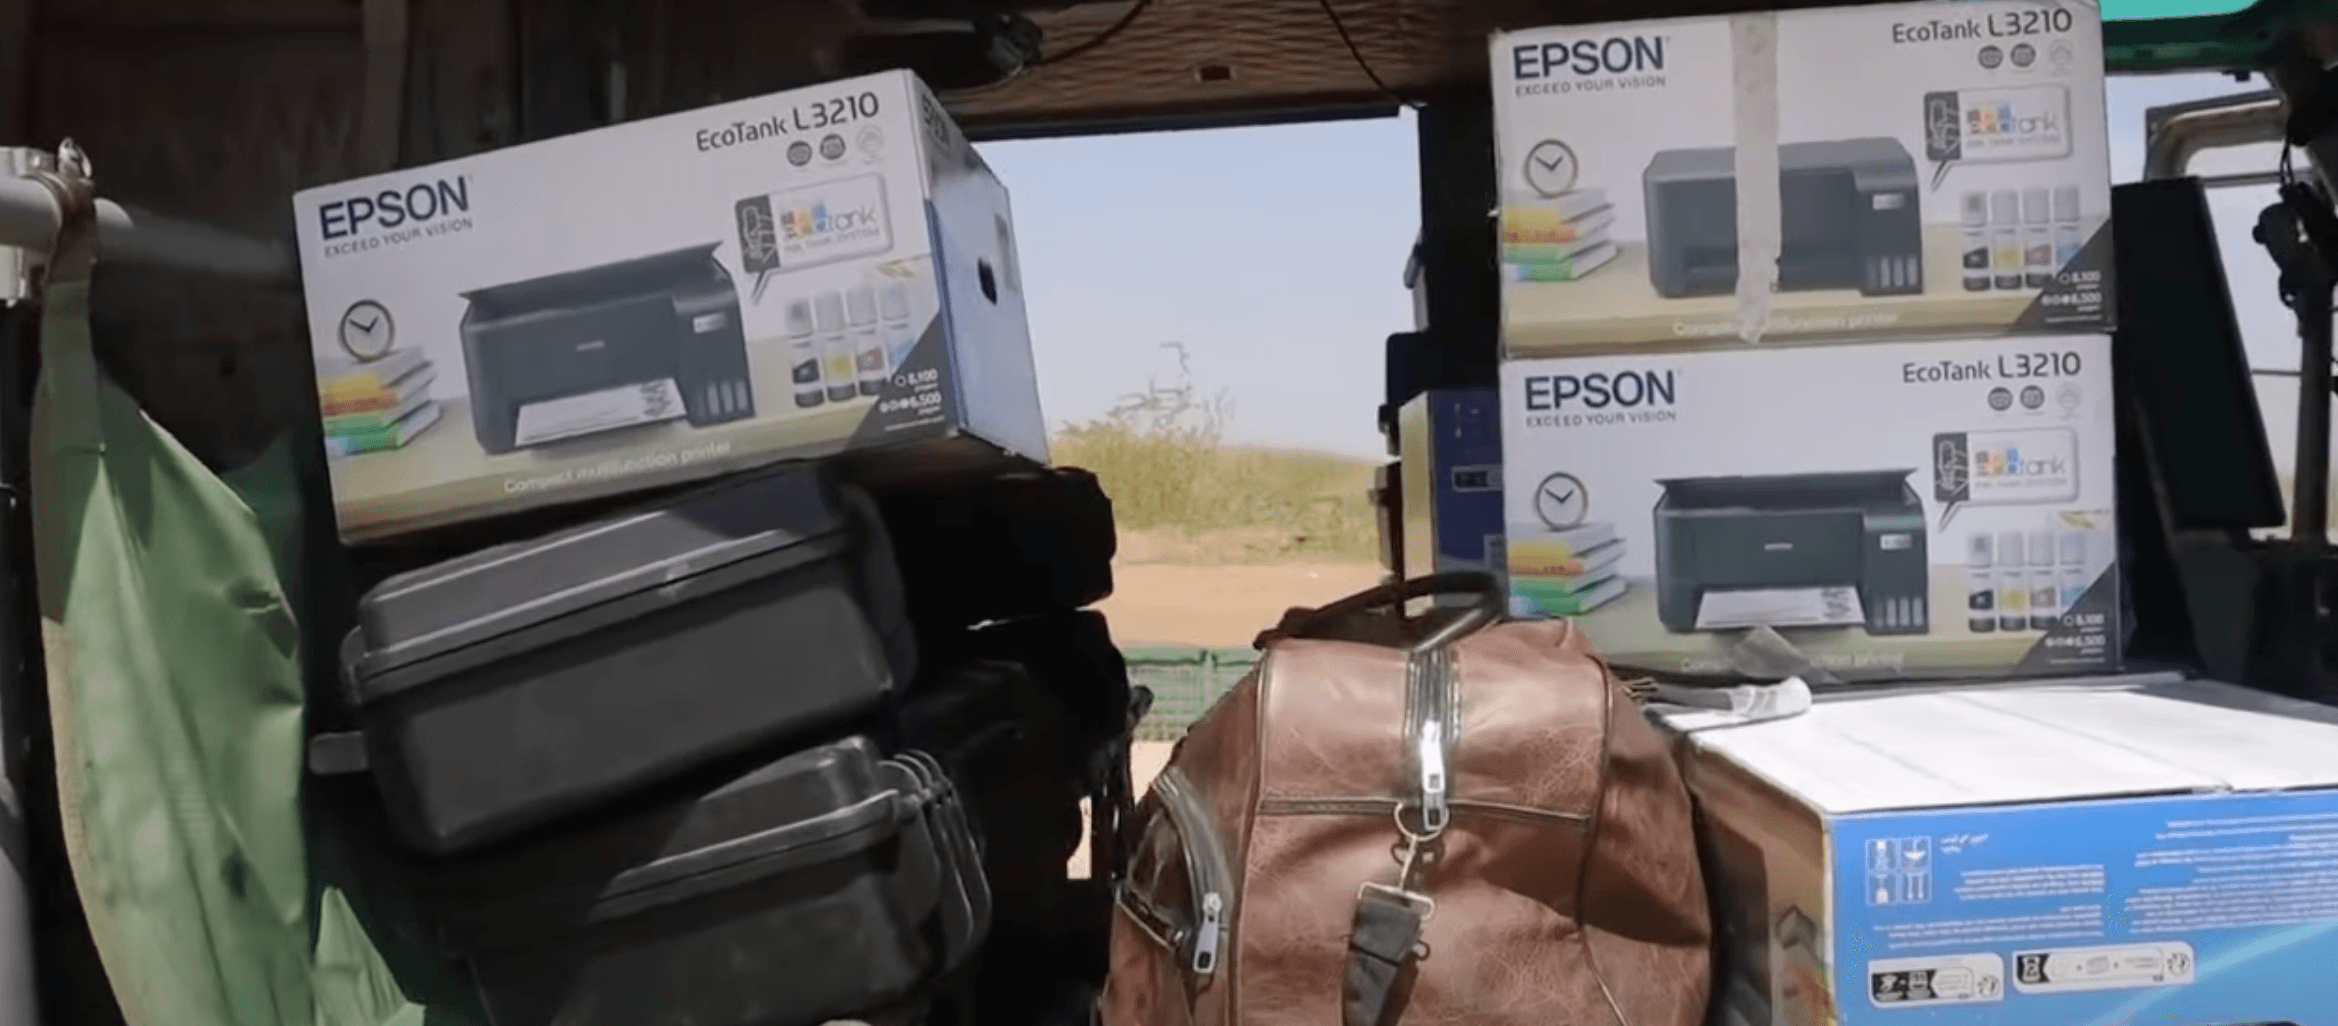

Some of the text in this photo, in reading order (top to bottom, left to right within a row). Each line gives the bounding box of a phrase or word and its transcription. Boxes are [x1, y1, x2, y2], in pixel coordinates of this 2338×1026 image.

[1892, 8, 2073, 43] EcoTank L3210
[1513, 36, 1664, 80] EPSON
[1515, 76, 1667, 97] EXCEED YOUR VISION
[695, 91, 879, 151] EcoTank L3210
[319, 175, 469, 240] EPSON
[324, 218, 473, 258] EXCEED YOUR VISION
[1902, 352, 2081, 383] EcoTank L3210
[1525, 370, 1675, 411] EPSON
[1526, 410, 1677, 428] EXCEED YOUR VISION
